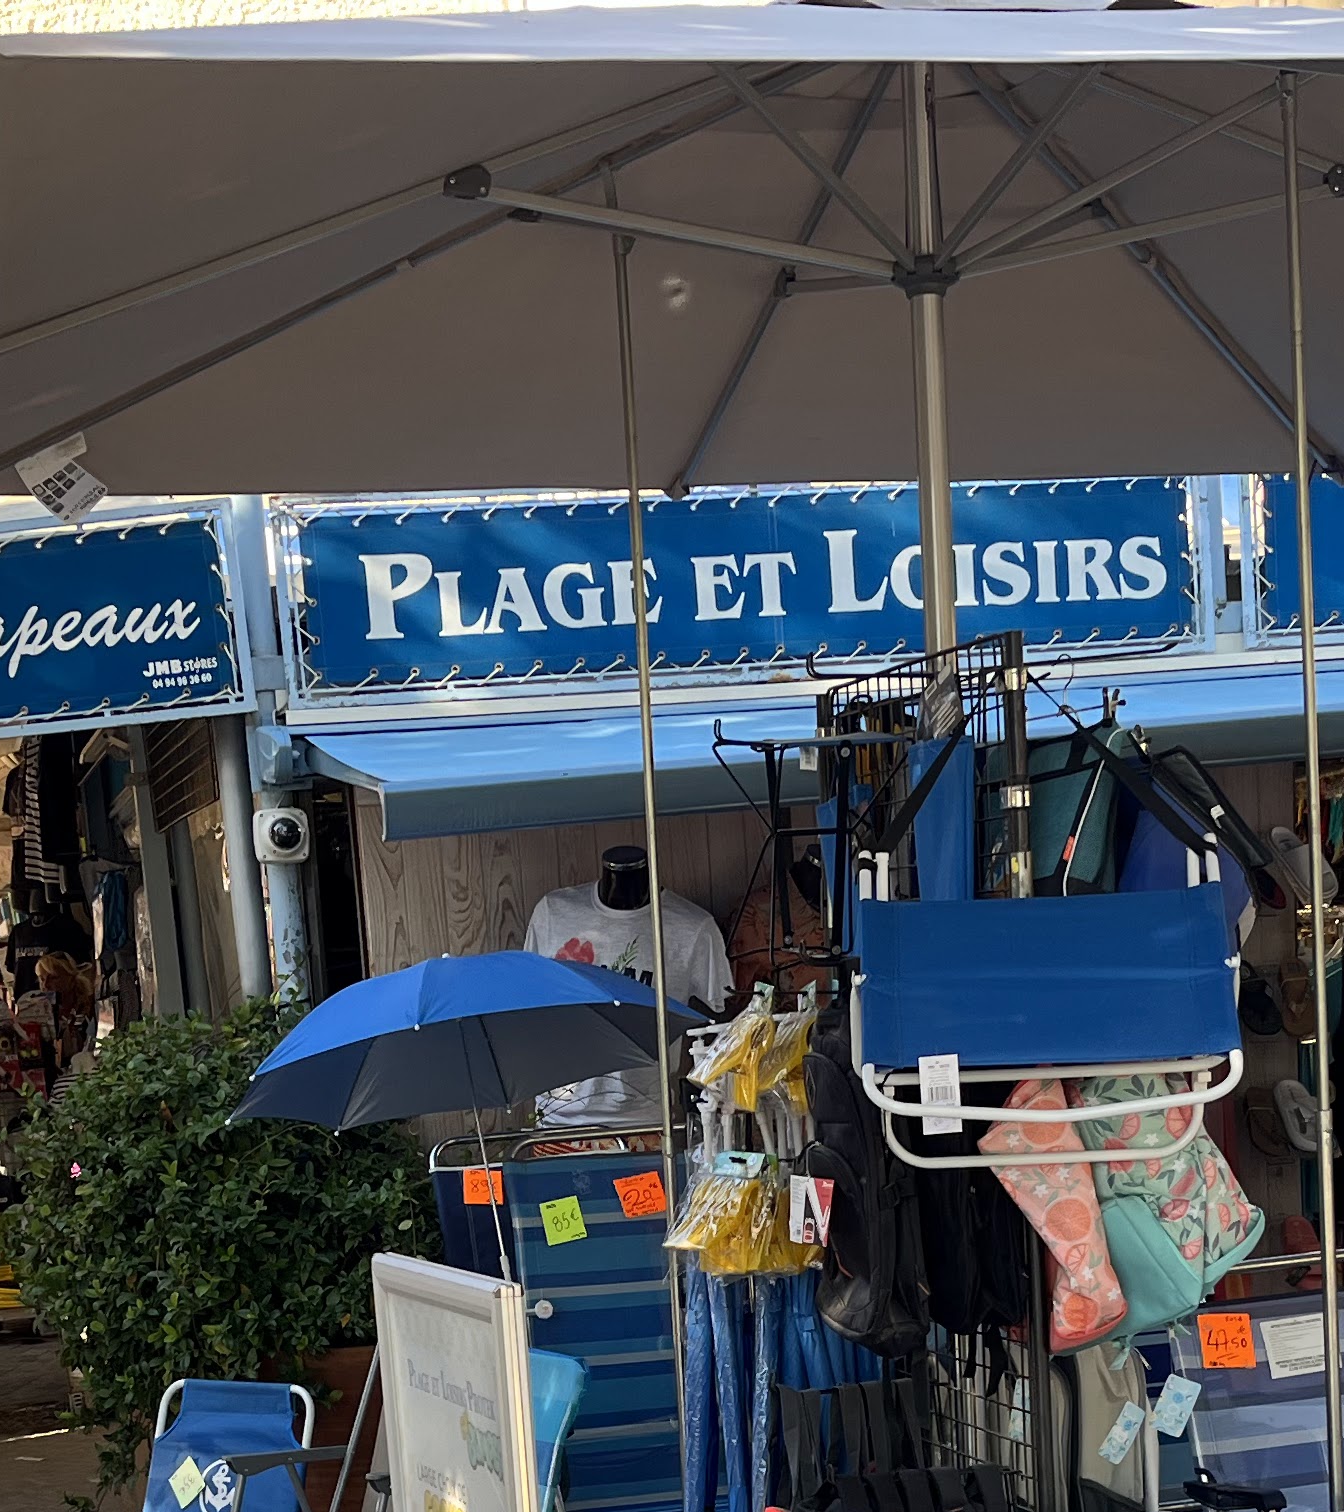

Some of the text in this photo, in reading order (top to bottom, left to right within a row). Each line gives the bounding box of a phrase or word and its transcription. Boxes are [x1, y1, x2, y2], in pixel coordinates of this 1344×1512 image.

[358, 550, 664, 640] PLAGE
[690, 550, 798, 621] ET
[142, 658, 182, 677] JMB
